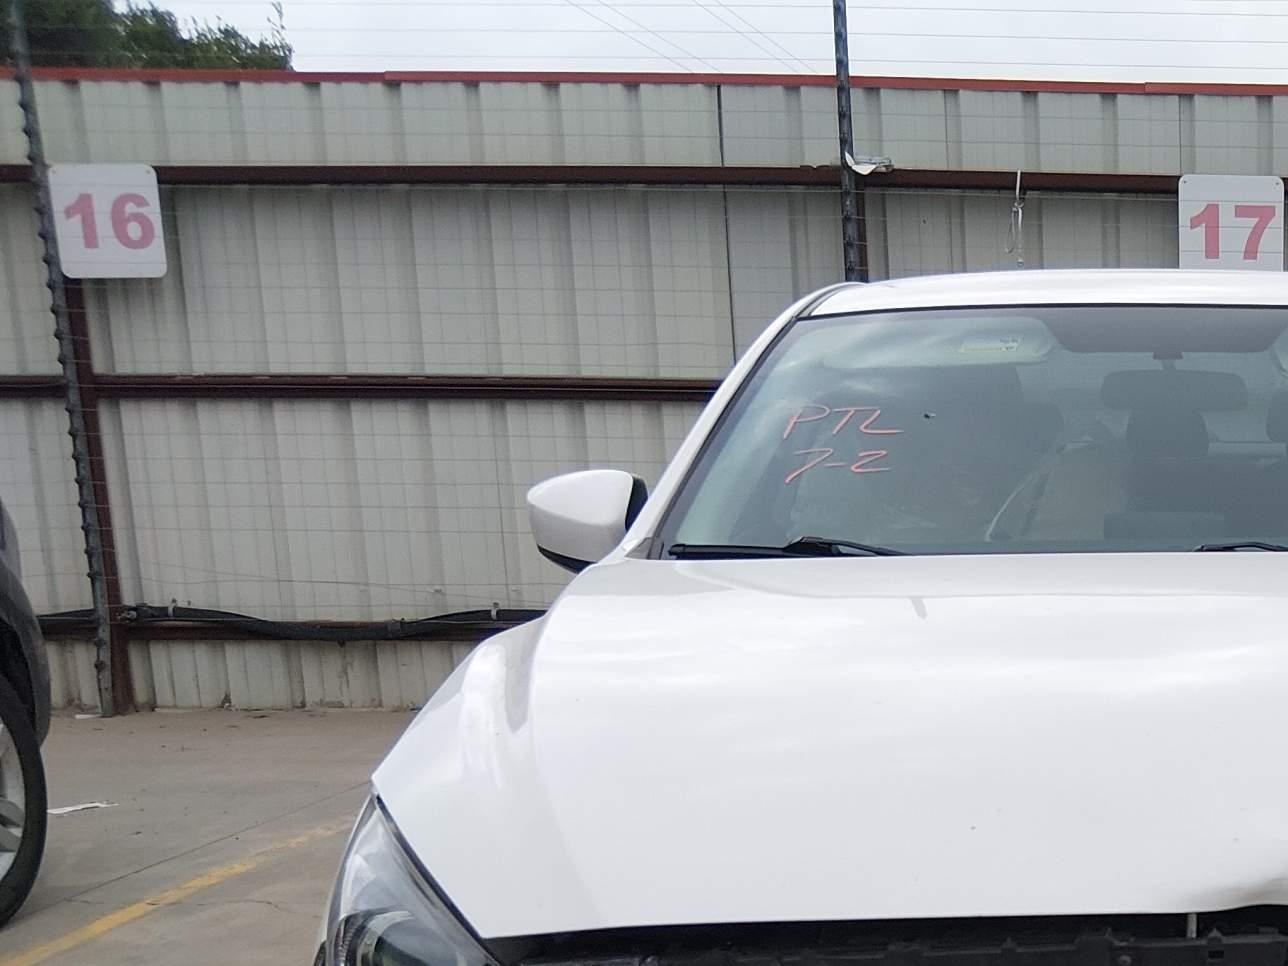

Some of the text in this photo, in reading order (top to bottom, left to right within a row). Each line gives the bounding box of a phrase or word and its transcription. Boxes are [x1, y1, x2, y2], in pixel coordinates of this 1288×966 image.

[64, 193, 156, 250] 16
[1189, 204, 1277, 260] 17
[784, 448, 891, 483] 7-2
